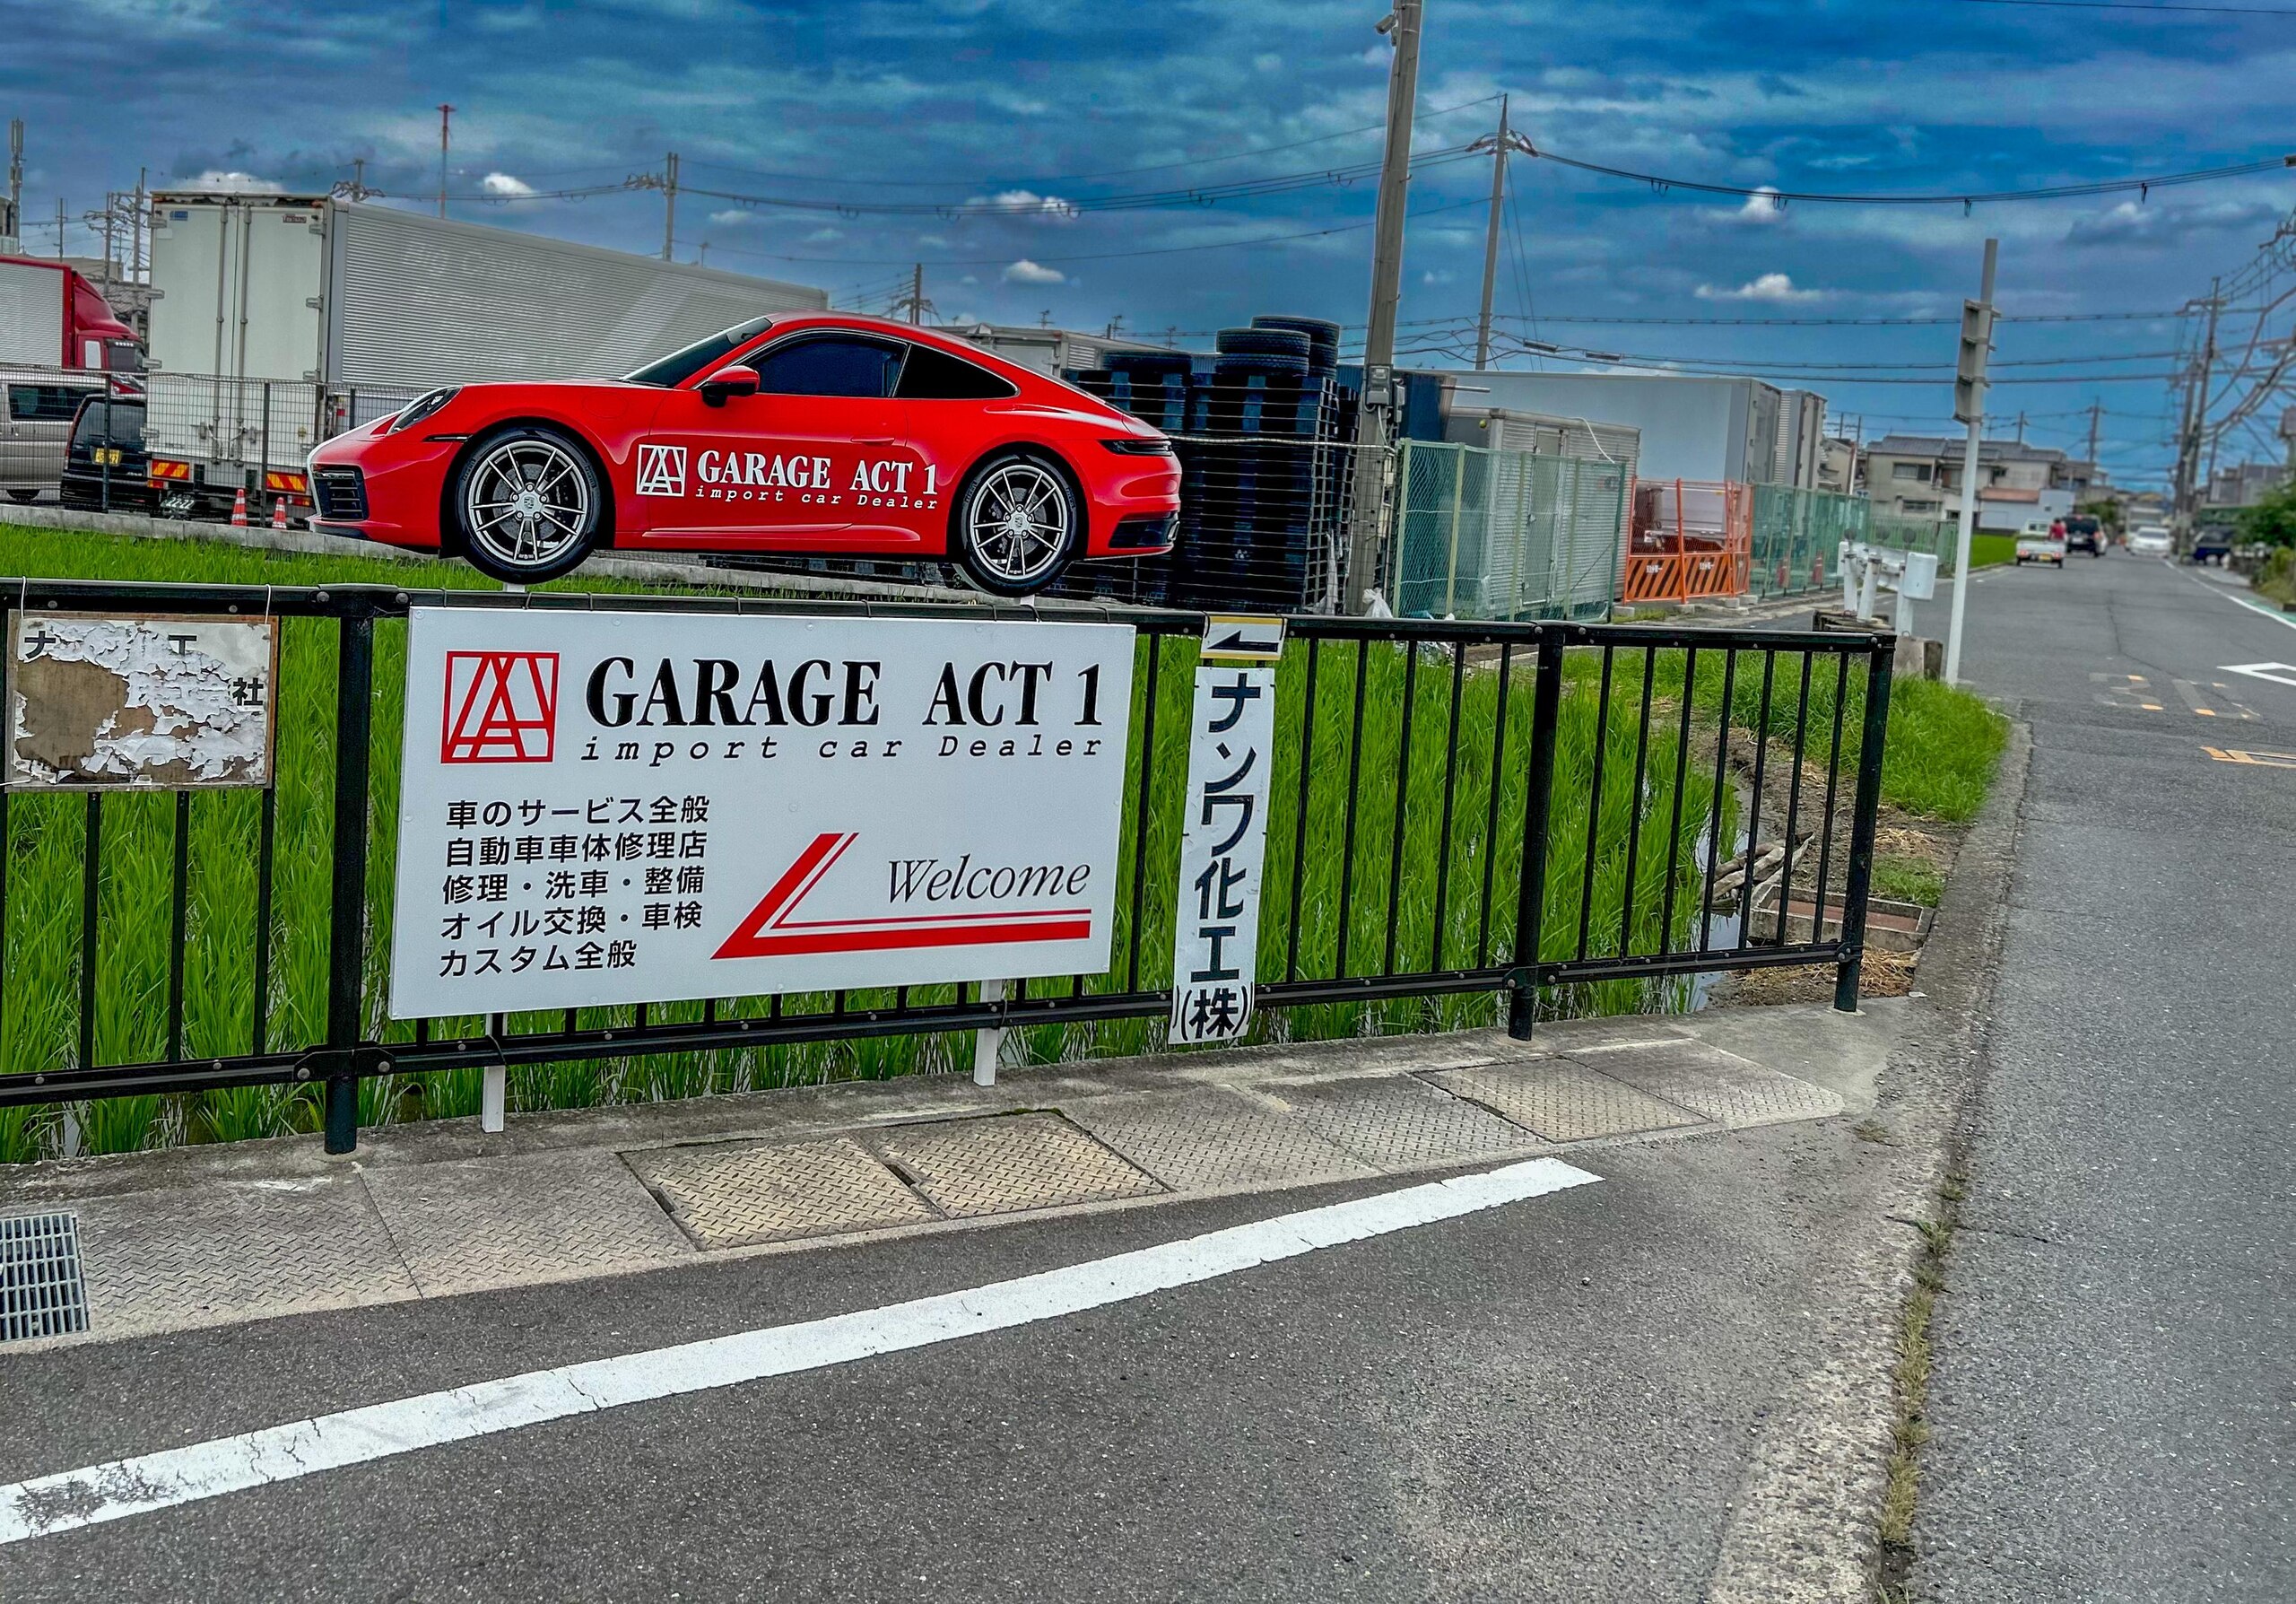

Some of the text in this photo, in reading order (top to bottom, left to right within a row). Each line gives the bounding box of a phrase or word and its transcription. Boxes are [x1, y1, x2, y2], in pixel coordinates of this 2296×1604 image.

[696, 449, 831, 489] GARAGE
[849, 459, 913, 493] ACT
[923, 464, 938, 495] 1
[695, 485, 938, 510] import car Dealer
[231, 676, 265, 706] 社
[585, 656, 1102, 728] GARAGE ACT 1
[580, 734, 1101, 768] import car Dealer
[446, 795, 710, 830] 車のサービス全般
[446, 830, 708, 867] 自動車車体修理店
[442, 866, 705, 904] 修理・洗車・整備
[887, 852, 1091, 904] Welcome
[440, 901, 703, 940] オイル交換・車検
[439, 939, 638, 977] カスタム全般
